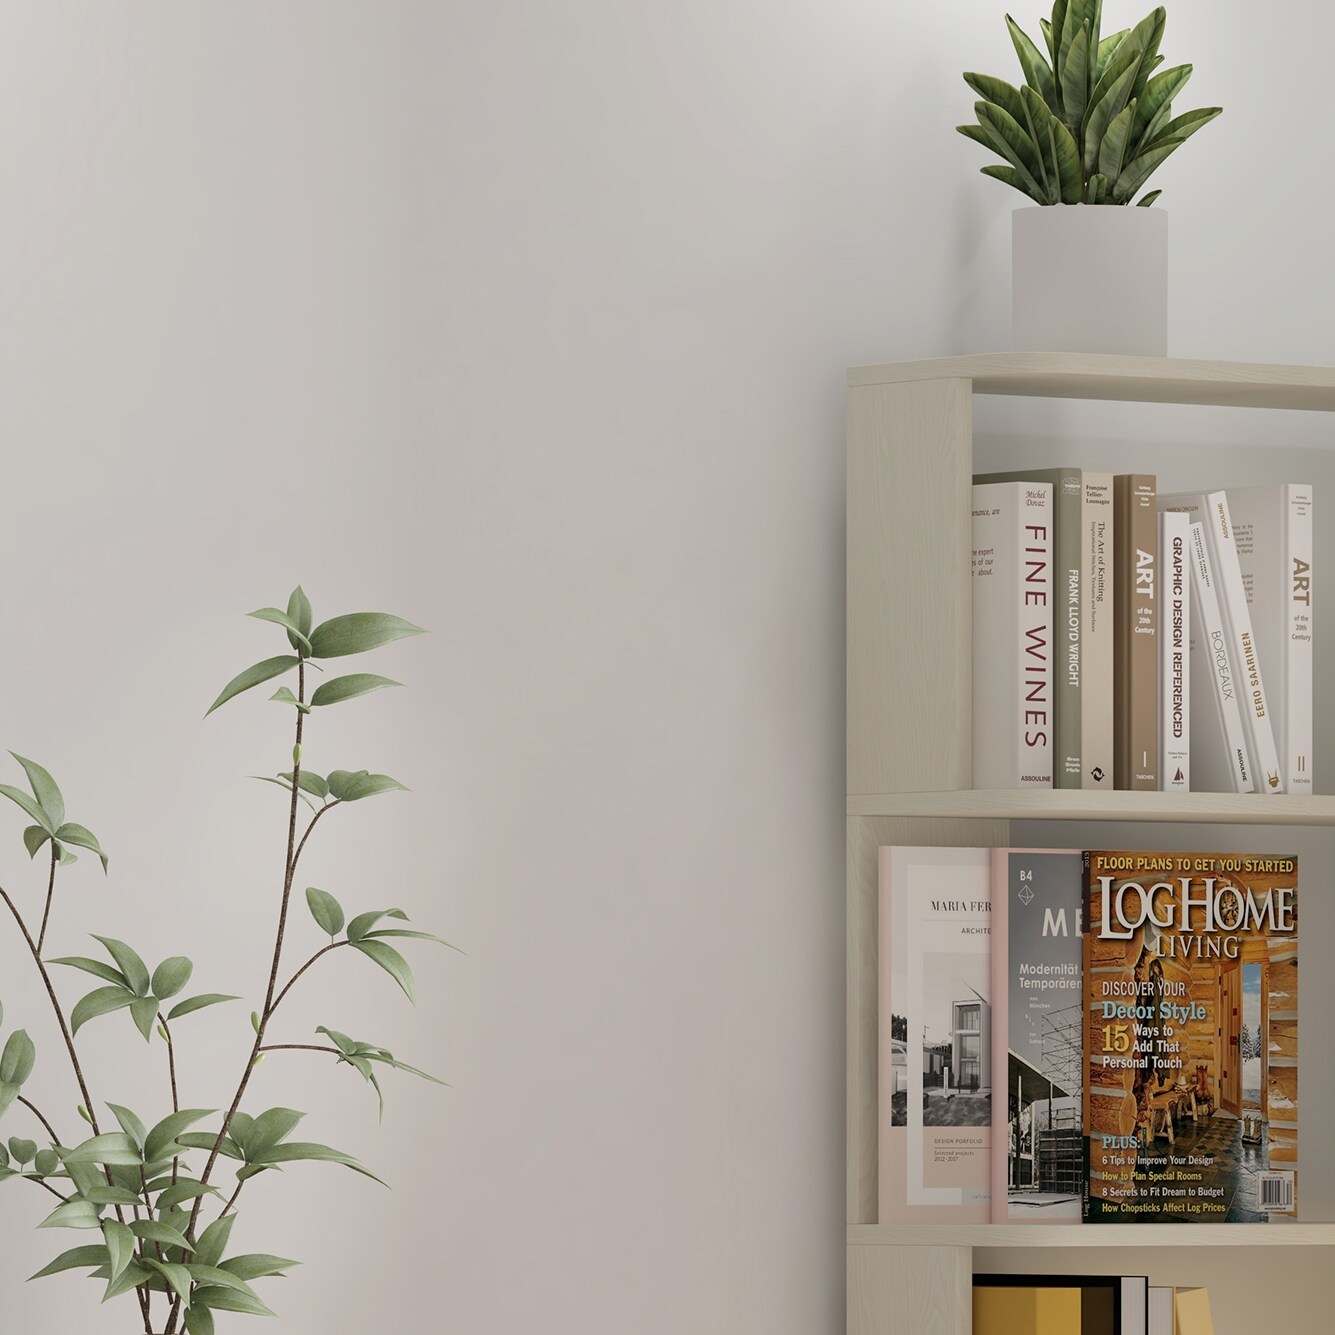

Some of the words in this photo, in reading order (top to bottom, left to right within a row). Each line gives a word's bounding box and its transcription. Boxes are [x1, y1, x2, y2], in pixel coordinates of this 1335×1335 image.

[1025, 490, 1046, 499] Michel
[1025, 526, 1046, 606] FINE
[1098, 556, 1105, 566] of
[1173, 537, 1182, 596] GRAPHIC
[1136, 549, 1154, 599] ART
[1293, 558, 1310, 606] ART
[1069, 569, 1079, 604] FRANK
[1096, 567, 1105, 602] Knitting
[1069, 607, 1079, 641] LLOYD
[1135, 626, 1155, 635] Century
[1173, 600, 1182, 647] DESIGN
[1292, 633, 1311, 642] Century
[1068, 644, 1079, 687] WRIGHT
[1212, 631, 1234, 701] BORDEAUX
[1241, 632, 1259, 687] SAARINEN
[1025, 625, 1047, 747] WINES
[1173, 652, 1182, 738] REFERENCED
[1253, 690, 1265, 718] EERO
[1097, 857, 1134, 870] FLOOR
[1137, 858, 1173, 870] PLANS
[1177, 859, 1190, 870] TO
[1194, 859, 1215, 871] GET
[1220, 859, 1241, 872] YOU
[1245, 860, 1294, 873] STARTED
[1020, 870, 1033, 881] B4
[931, 900, 967, 912] MARIA
[1156, 936, 1240, 958] LIVING
[1019, 963, 1078, 974] Modernität
[1102, 982, 1154, 996] DISCOVER
[1158, 982, 1185, 996] YOUR
[1102, 1001, 1154, 1019] Decor
[1159, 1001, 1206, 1024] Style
[1102, 1025, 1129, 1052] 15
[1133, 1024, 1159, 1037] Ways
[1163, 1024, 1173, 1036] to
[1133, 1040, 1153, 1052] Add
[1156, 1040, 1180, 1052] That
[1102, 1056, 1148, 1069] Personal
[1152, 1056, 1182, 1069] Touch
[1102, 1136, 1141, 1149] PLUS:
[1102, 1156, 1108, 1165] 6
[1110, 1156, 1125, 1166] Tips
[1127, 1156, 1135, 1165] to
[1137, 1156, 1168, 1166] Improve
[1170, 1156, 1186, 1165] Your
[1188, 1156, 1214, 1167] Design
[1102, 1172, 1119, 1181] How
[1121, 1172, 1128, 1181] to
[1131, 1172, 1147, 1181] Plan
[1149, 1172, 1175, 1182] Special
[1177, 1172, 1202, 1181] Rooms
[1102, 1188, 1108, 1196] 8
[1110, 1188, 1138, 1196] Secrets
[1140, 1188, 1148, 1196] to
[1150, 1187, 1159, 1196] Fit
[1162, 1187, 1186, 1196] Dream
[1188, 1188, 1196, 1196] to
[1198, 1187, 1224, 1198] Budget
[1102, 1203, 1118, 1212] How
[1120, 1203, 1160, 1214] Chopsticks
[1162, 1203, 1185, 1212] Affect
[1187, 1203, 1200, 1214] Log
[1202, 1203, 1226, 1212] Prices
